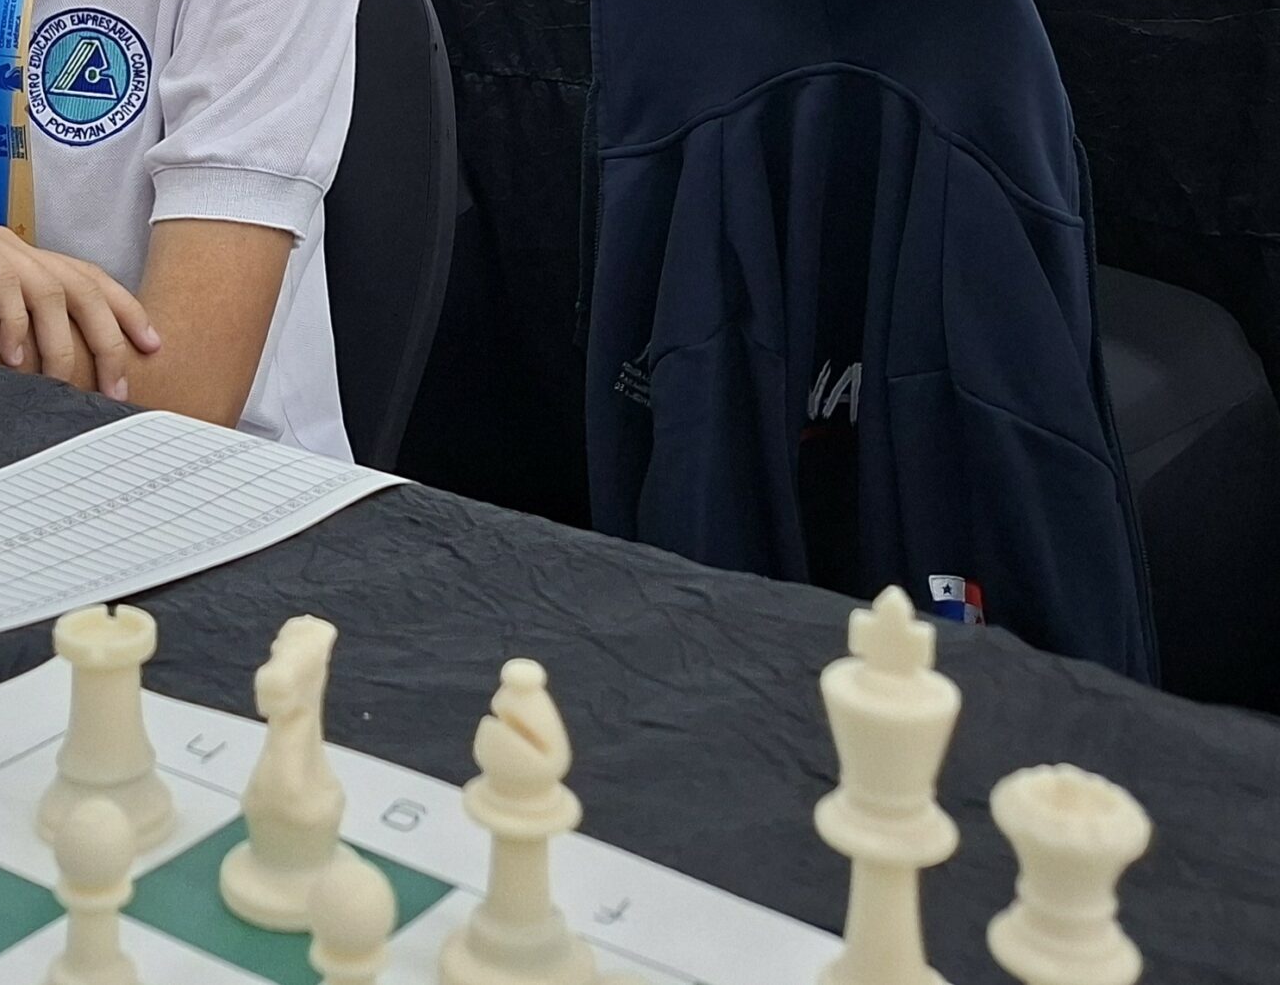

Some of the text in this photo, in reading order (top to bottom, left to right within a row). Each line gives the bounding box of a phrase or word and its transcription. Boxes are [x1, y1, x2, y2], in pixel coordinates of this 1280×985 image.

[28, 13, 146, 127] CENTRO EDUCATIVO EMPRESARIAL COMFACAUCA
[45, 116, 107, 140] POPAYAN
